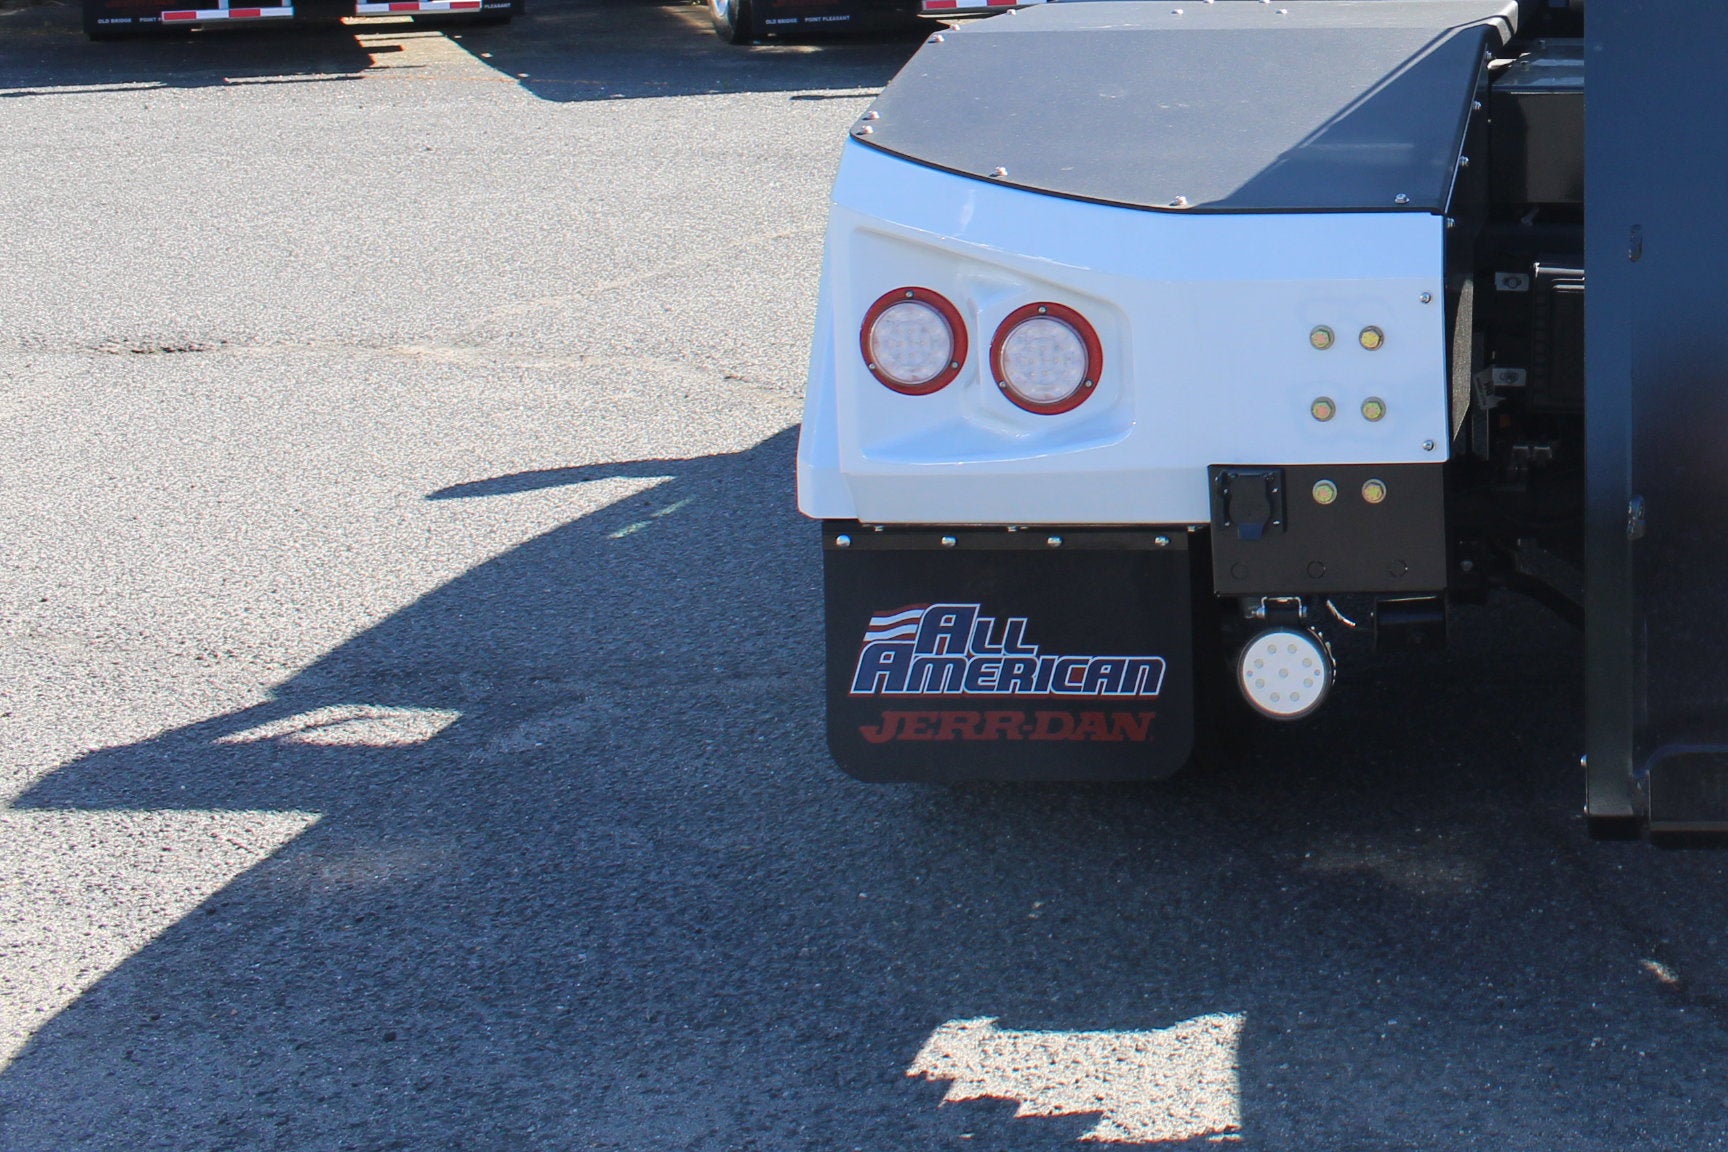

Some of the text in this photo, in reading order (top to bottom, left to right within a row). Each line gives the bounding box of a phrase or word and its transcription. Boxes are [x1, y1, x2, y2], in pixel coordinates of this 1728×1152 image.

[915, 603, 1040, 656] ALL
[850, 641, 1167, 696] AMERICAN
[859, 710, 1157, 743] JERR-DAN
